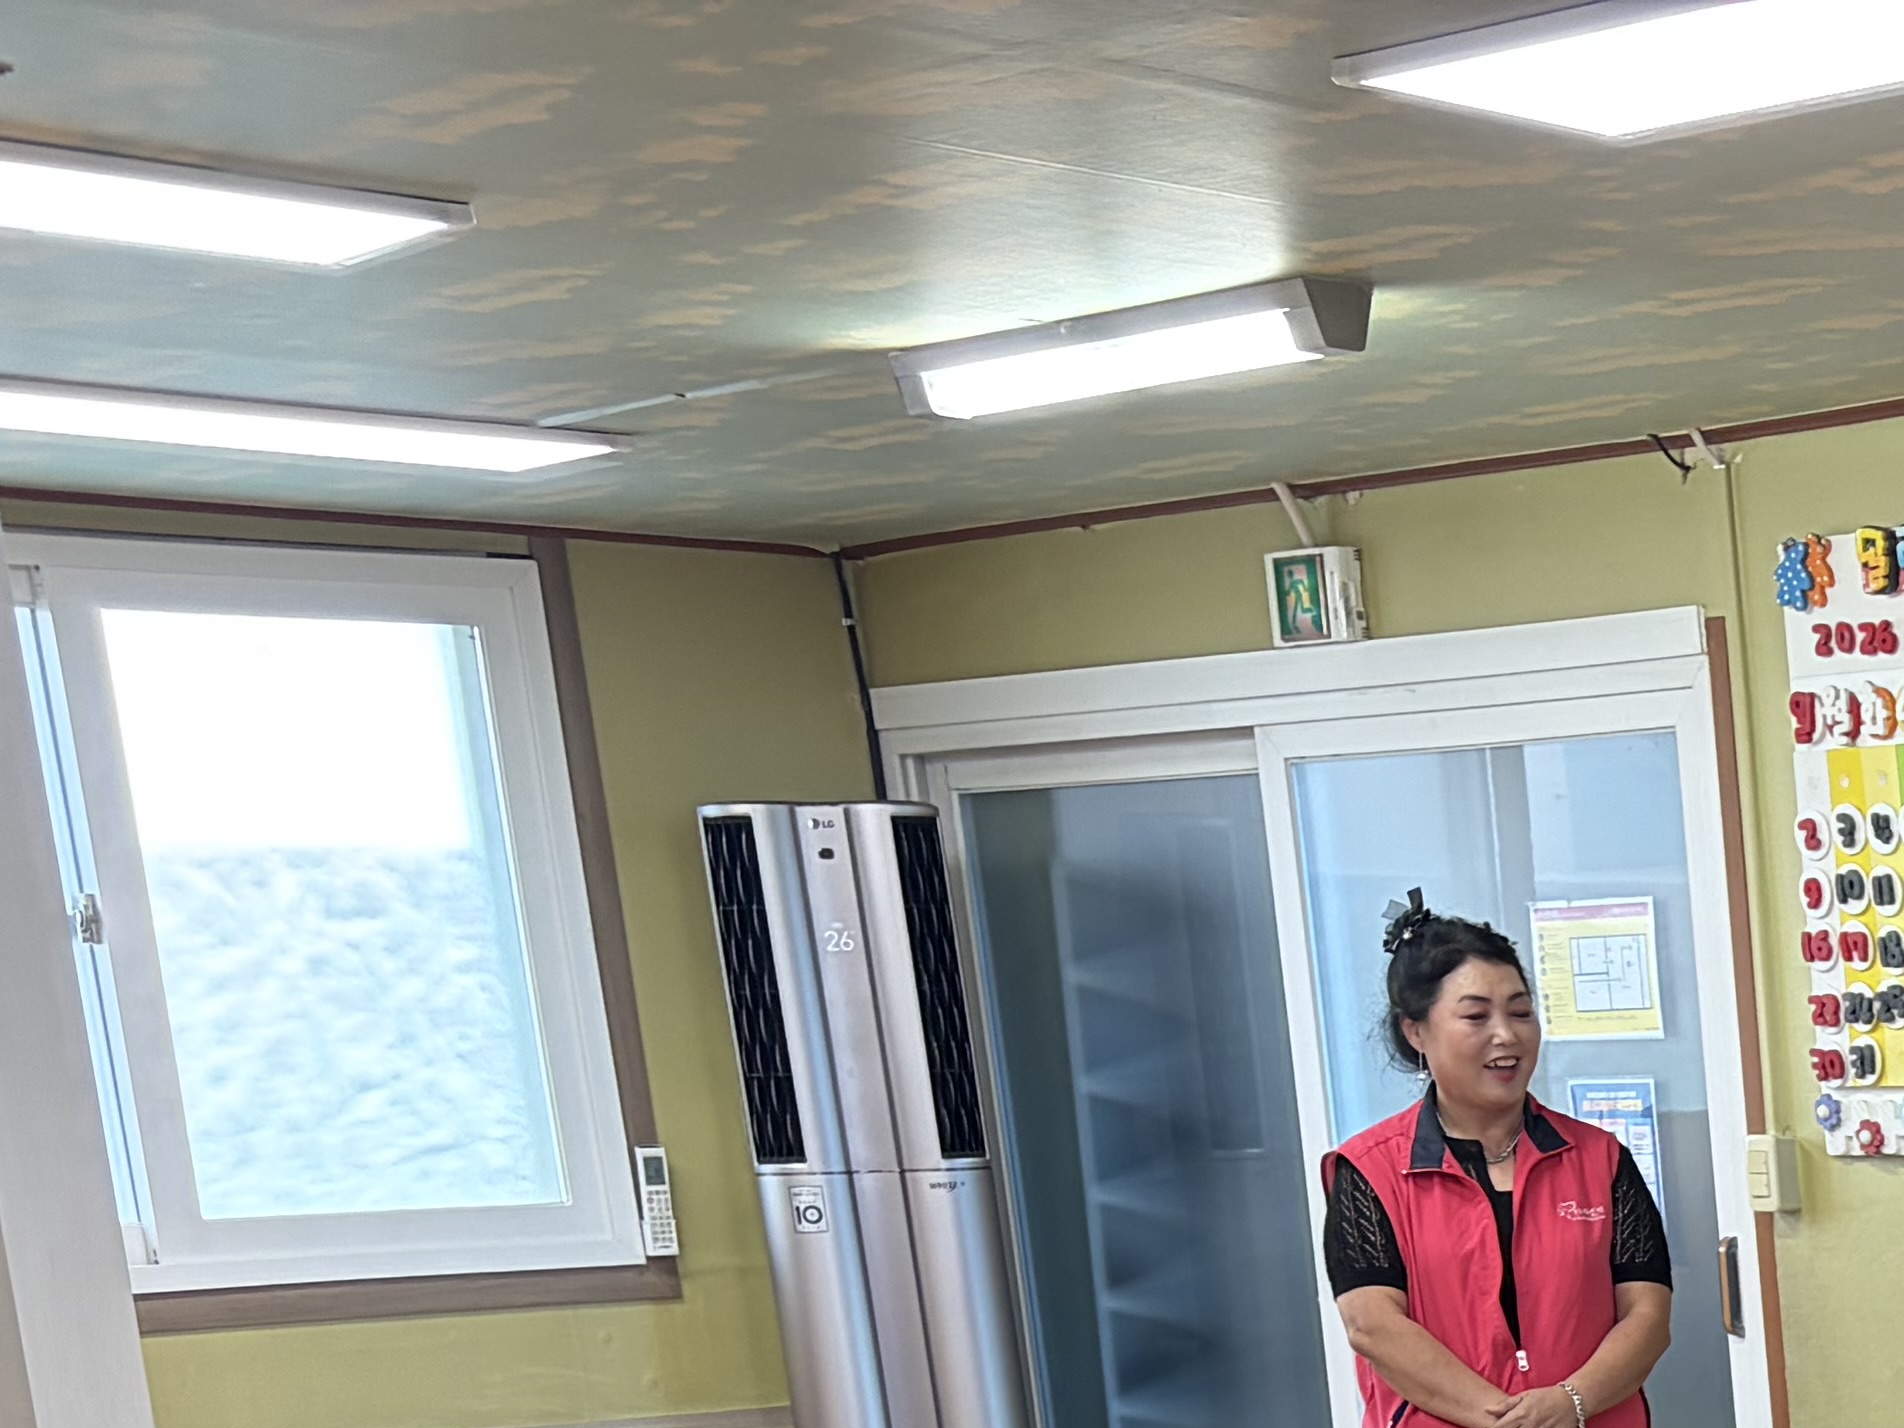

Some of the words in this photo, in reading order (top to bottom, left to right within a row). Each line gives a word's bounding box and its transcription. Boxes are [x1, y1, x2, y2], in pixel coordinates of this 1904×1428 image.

[1812, 620, 1900, 657] 2026
[821, 819, 835, 829] LG
[1798, 818, 1822, 850] 2
[1836, 812, 1857, 848] 3
[1803, 877, 1822, 910] 9
[1835, 869, 1865, 905] 10
[1871, 873, 1896, 906] 11
[824, 930, 855, 952] 26
[1801, 930, 1834, 963] 16
[1839, 931, 1870, 963] 17
[1808, 994, 1841, 1027] 23
[1809, 1048, 1845, 1082] 30
[1851, 1045, 1876, 1080] 31
